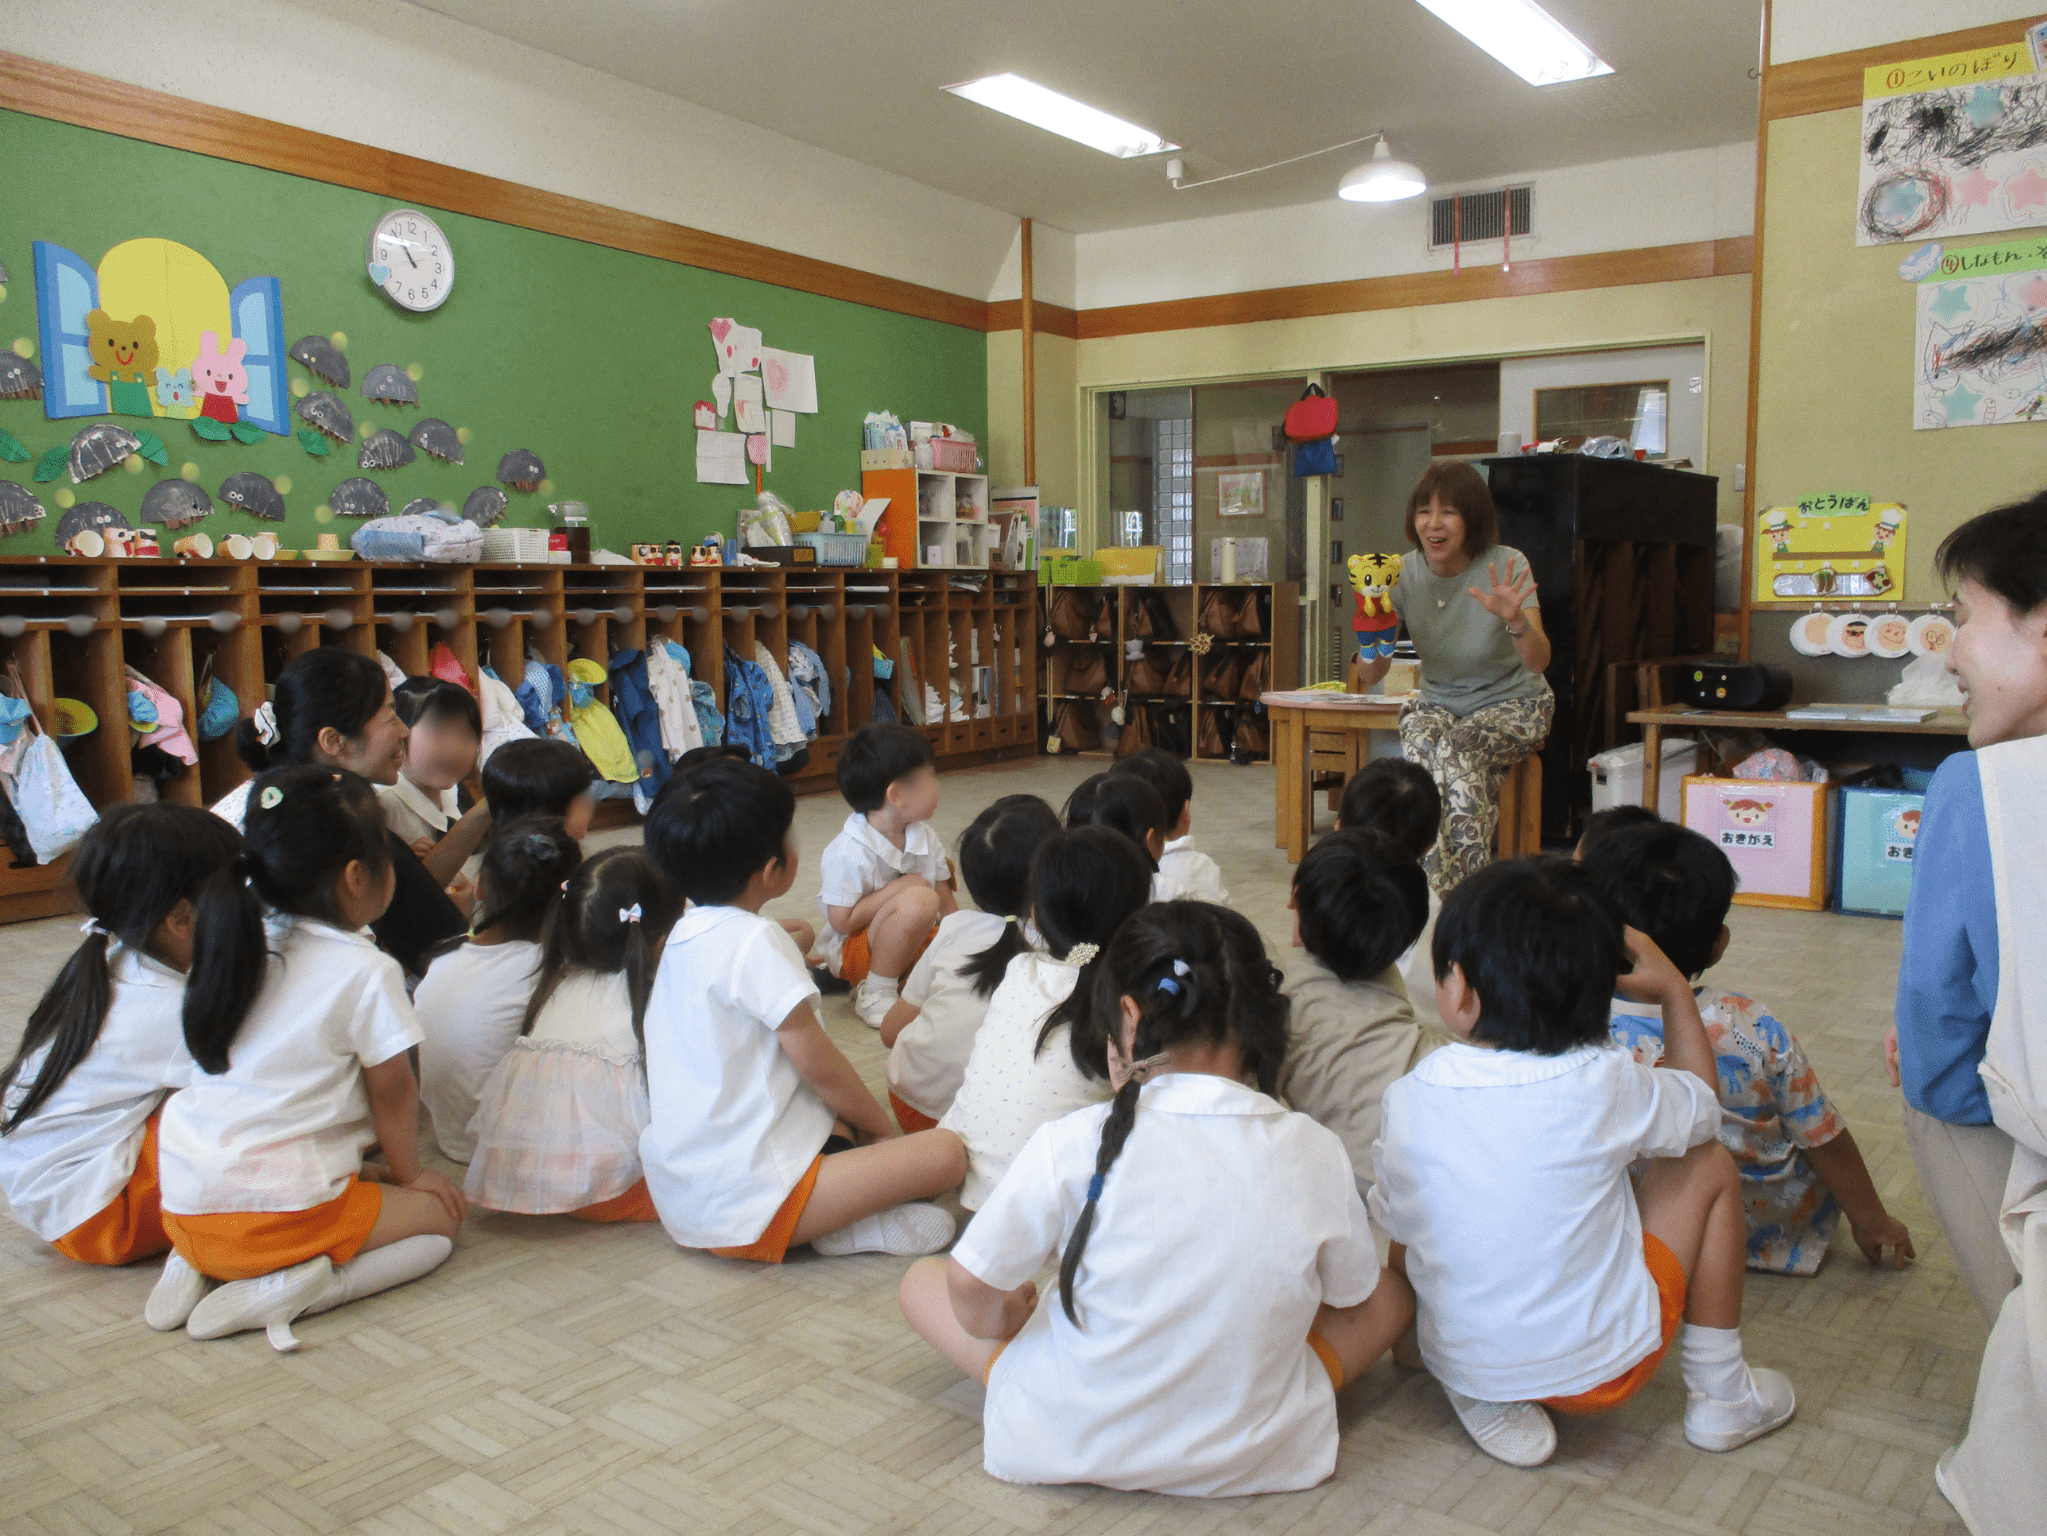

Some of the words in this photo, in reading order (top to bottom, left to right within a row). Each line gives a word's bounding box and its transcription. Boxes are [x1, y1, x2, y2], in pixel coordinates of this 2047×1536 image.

[407, 221, 417, 235] 12
[380, 249, 388, 260] 9
[431, 244, 438, 257] 2
[435, 262, 442, 274] 3
[396, 281, 403, 293] 7
[430, 279, 438, 290] 4
[408, 288, 416, 300] 6
[421, 288, 429, 299] 5
[1799, 495, 1868, 513] おとうばん
[1722, 832, 1773, 846] おきがえ
